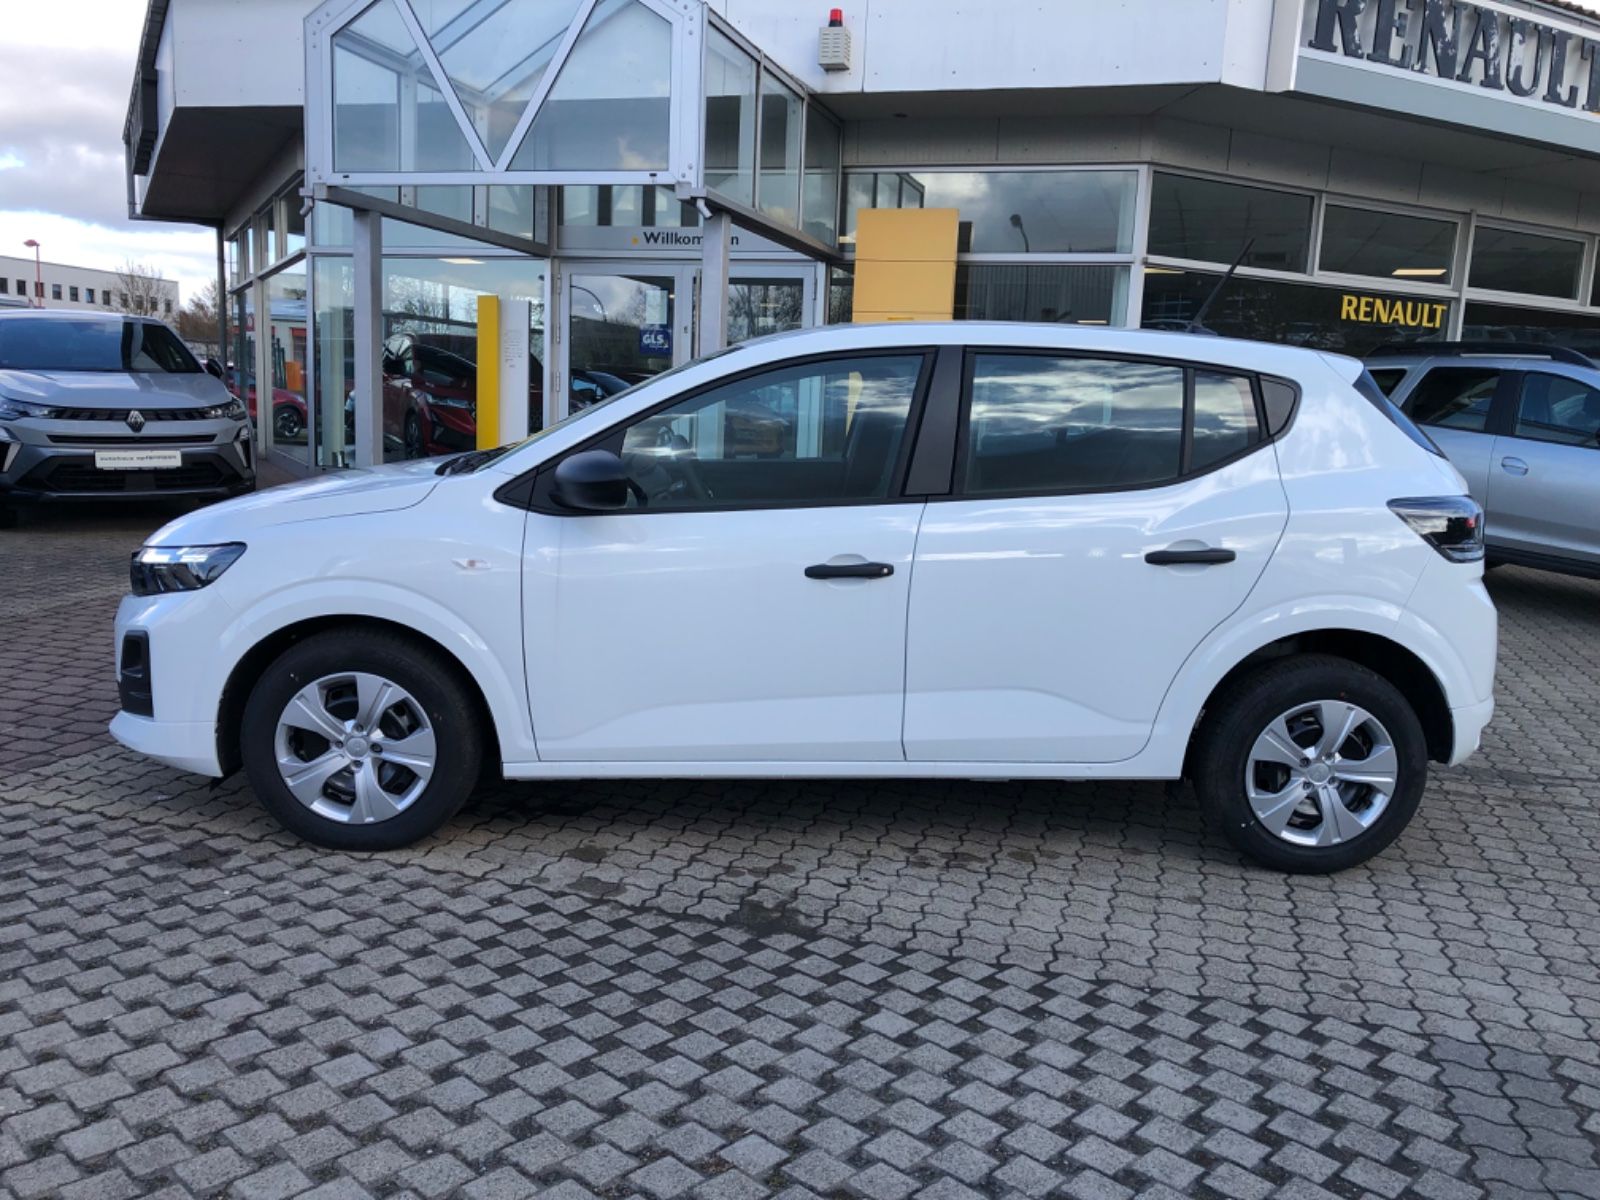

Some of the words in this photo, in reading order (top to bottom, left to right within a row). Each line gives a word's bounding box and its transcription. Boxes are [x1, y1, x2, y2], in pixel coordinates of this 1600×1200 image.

[643, 231, 739, 246] Willkomn
[1341, 294, 1448, 329] RENAULT
[642, 334, 665, 345] GLS
